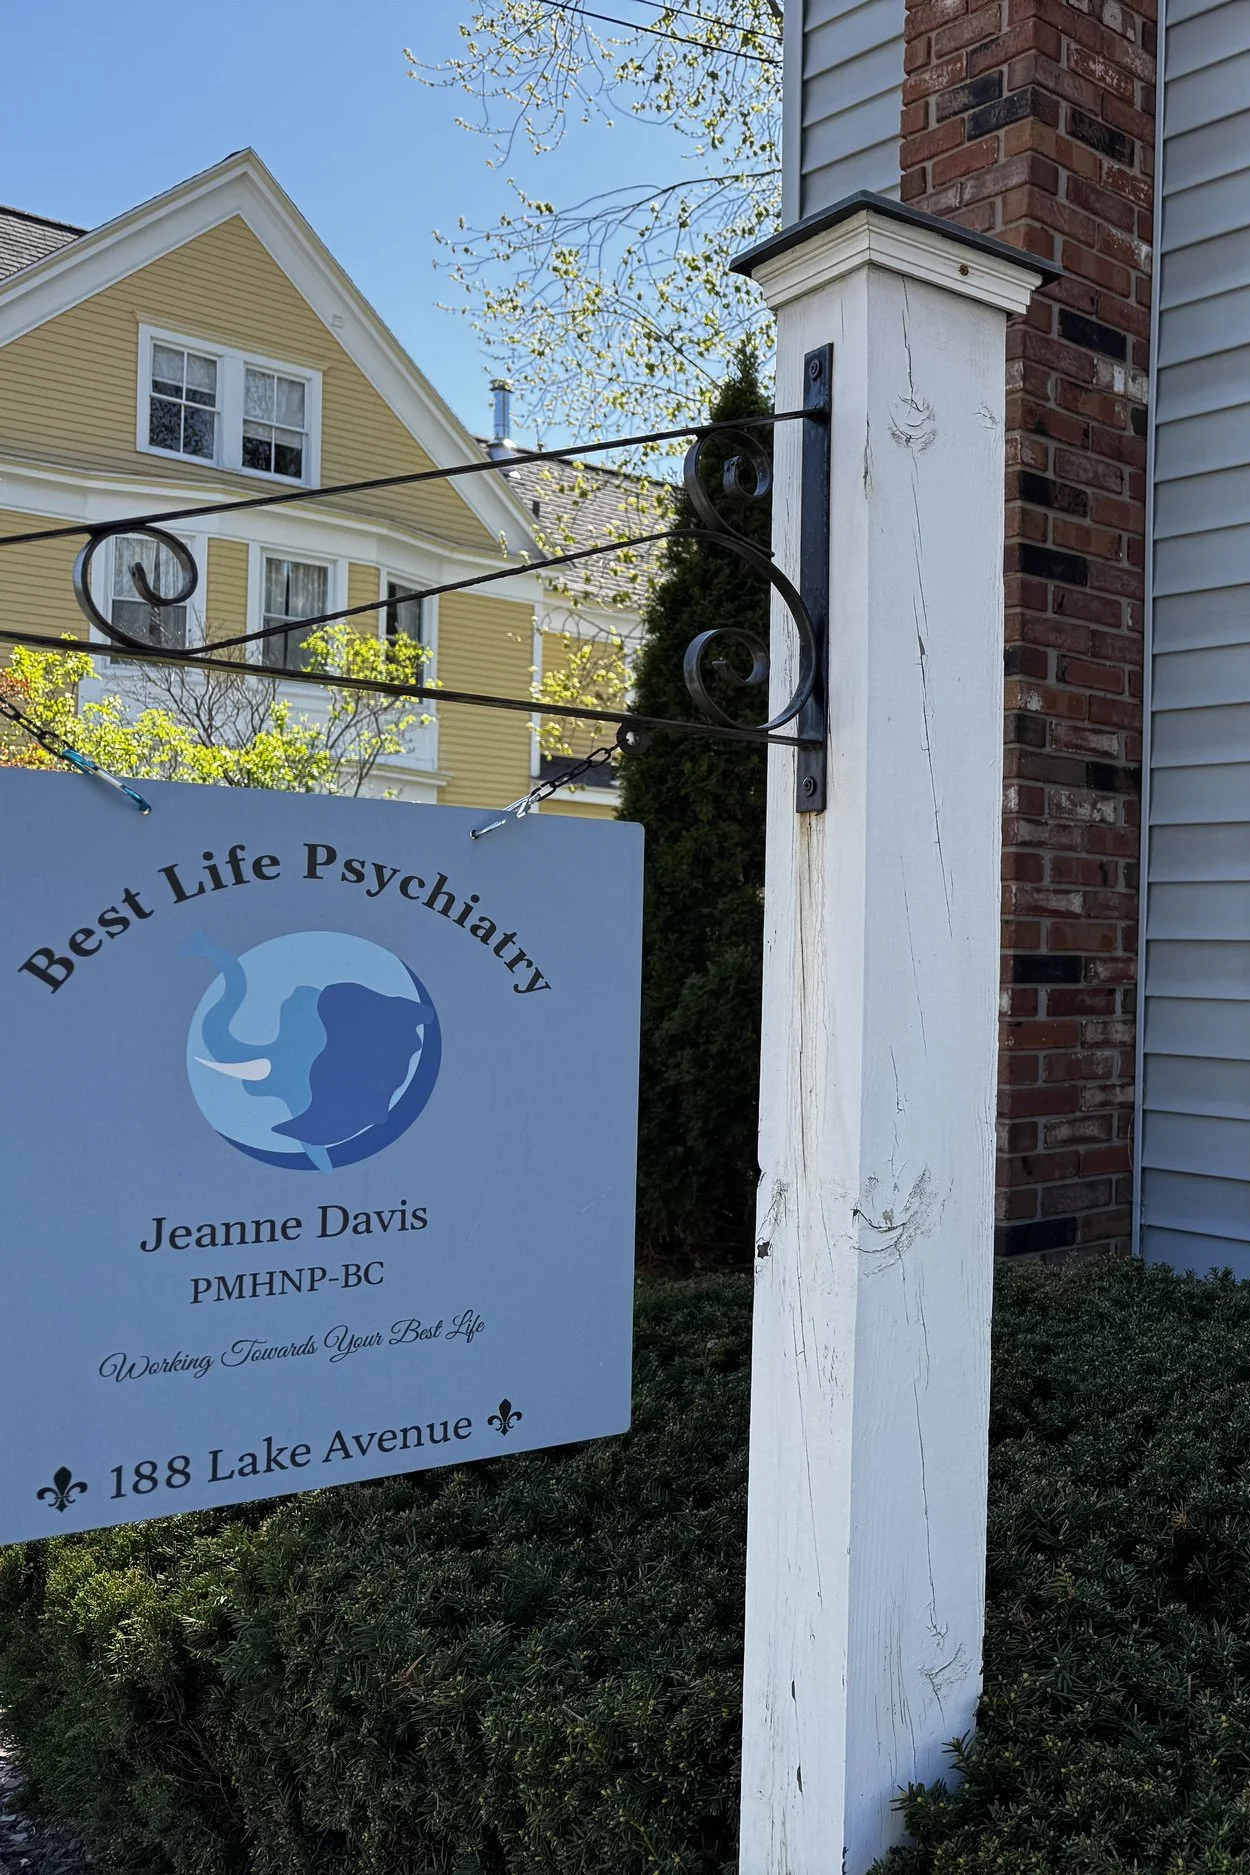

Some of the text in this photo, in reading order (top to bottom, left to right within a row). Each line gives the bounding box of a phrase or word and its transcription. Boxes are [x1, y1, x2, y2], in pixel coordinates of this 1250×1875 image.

[17, 842, 552, 996] Best Life Psychiatry
[140, 1199, 429, 1252] Jeanne Davis
[189, 1261, 385, 1304] PMHNP-BC
[99, 1309, 486, 1383] Working Towards Your Best Life
[109, 1416, 473, 1500] 188 Lake Avenue
